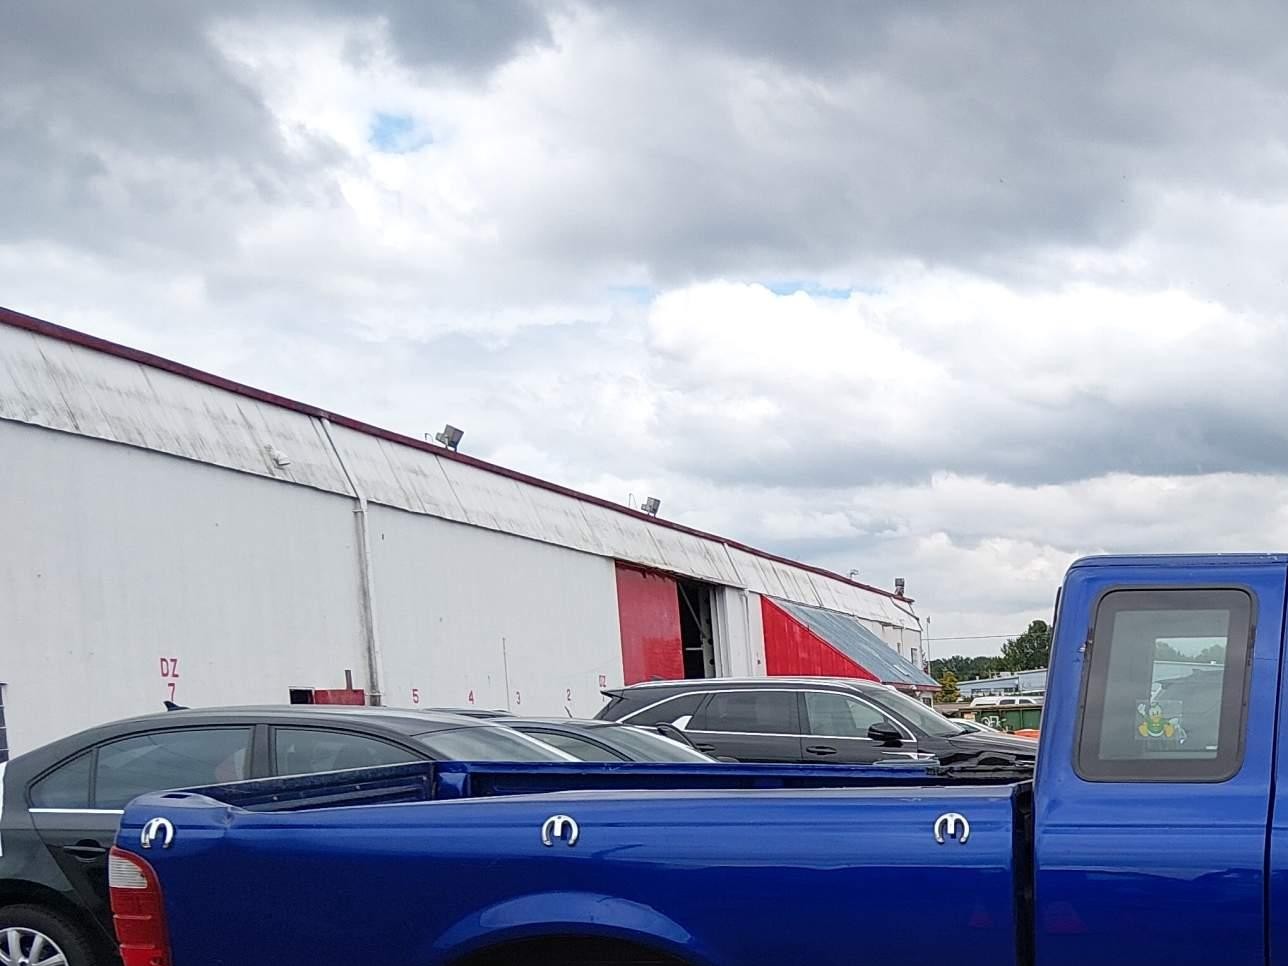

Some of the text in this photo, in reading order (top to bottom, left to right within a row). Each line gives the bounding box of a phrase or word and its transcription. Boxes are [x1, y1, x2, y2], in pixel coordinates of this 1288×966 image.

[160, 658, 180, 678] DZ
[167, 682, 176, 702] 7
[412, 688, 420, 704] 5
[468, 689, 475, 705] 4
[515, 691, 521, 705] 3
[566, 688, 571, 701] 2
